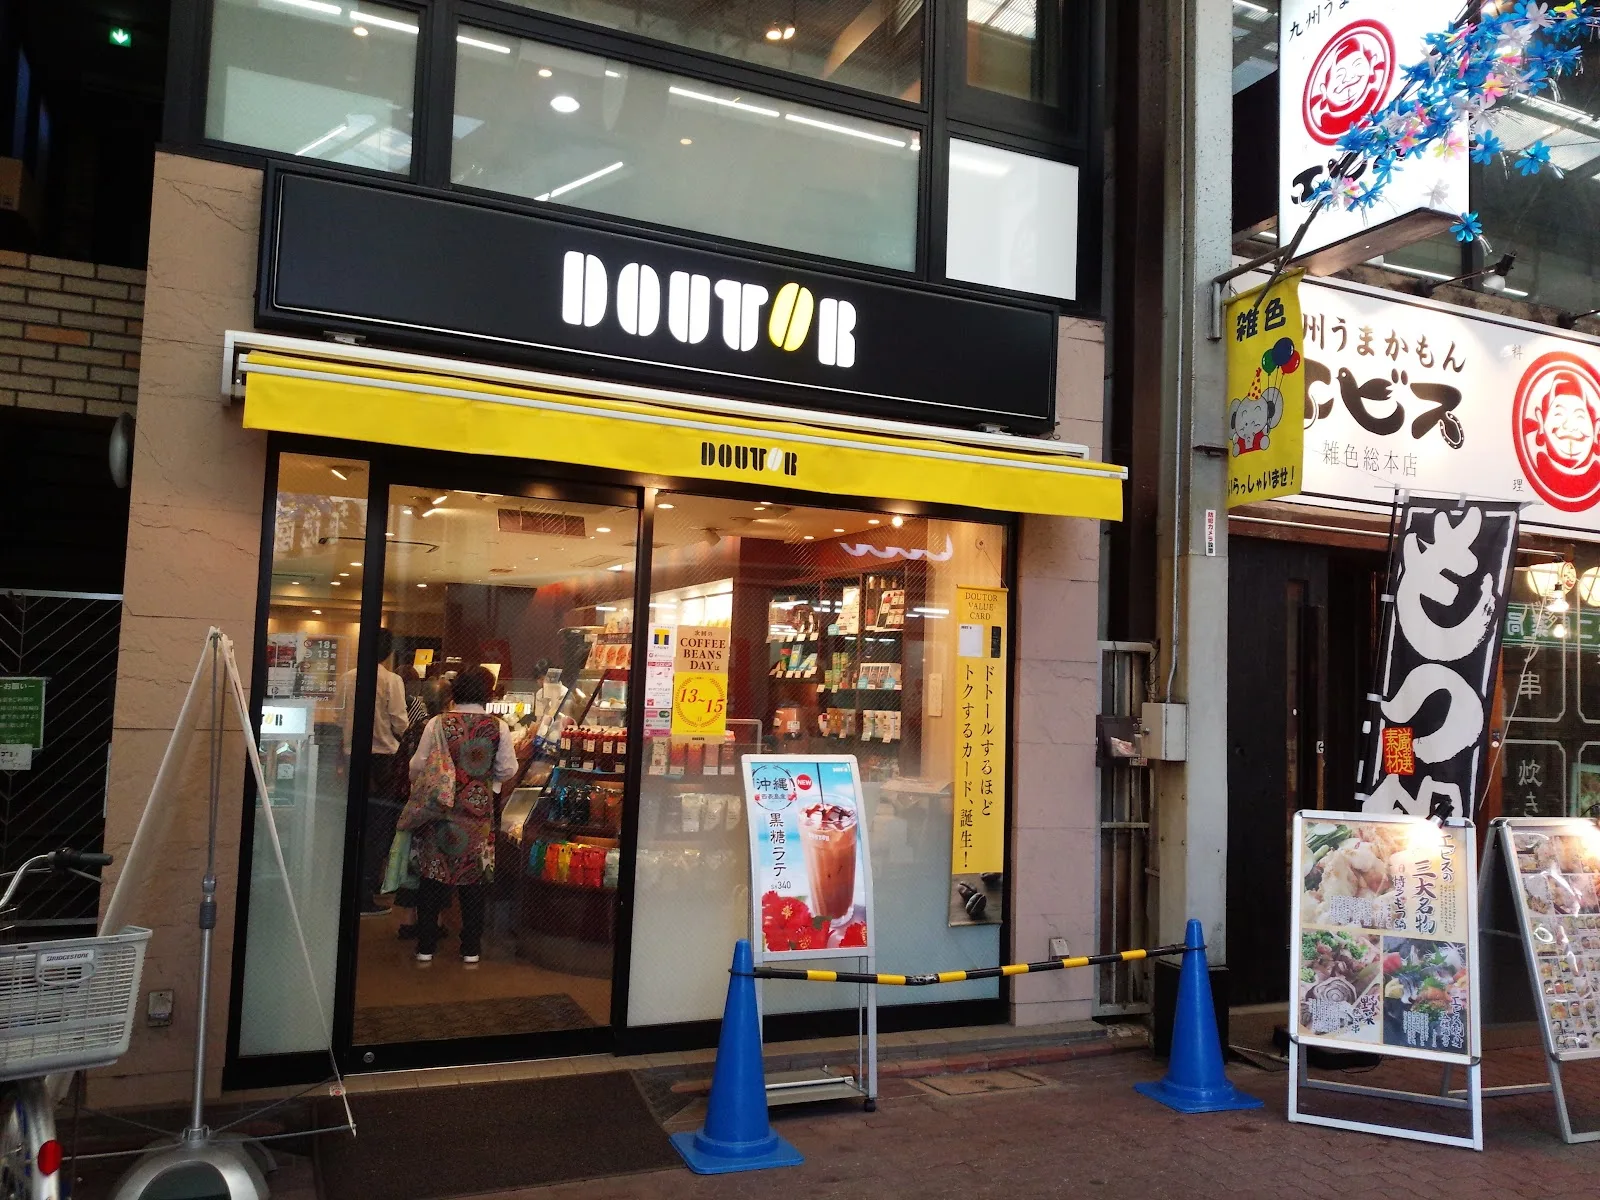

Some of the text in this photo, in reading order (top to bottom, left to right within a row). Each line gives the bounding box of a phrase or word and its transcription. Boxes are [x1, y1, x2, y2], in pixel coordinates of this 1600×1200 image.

[562, 250, 857, 368] DOUTOR
[1236, 298, 1286, 342] 雑色
[701, 441, 798, 476] DOUTOR
[1322, 440, 1418, 477] 雑色総本店
[1513, 478, 1524, 492] 理
[969, 612, 991, 620] CARD
[680, 638, 726, 649] COFFEE
[683, 649, 722, 660] BEANS
[980, 664, 995, 816] ドトールするほど
[756, 777, 789, 791] 沖縄
[769, 813, 787, 877] 黒糖ラテ
[1412, 859, 1438, 935] 三大名物
